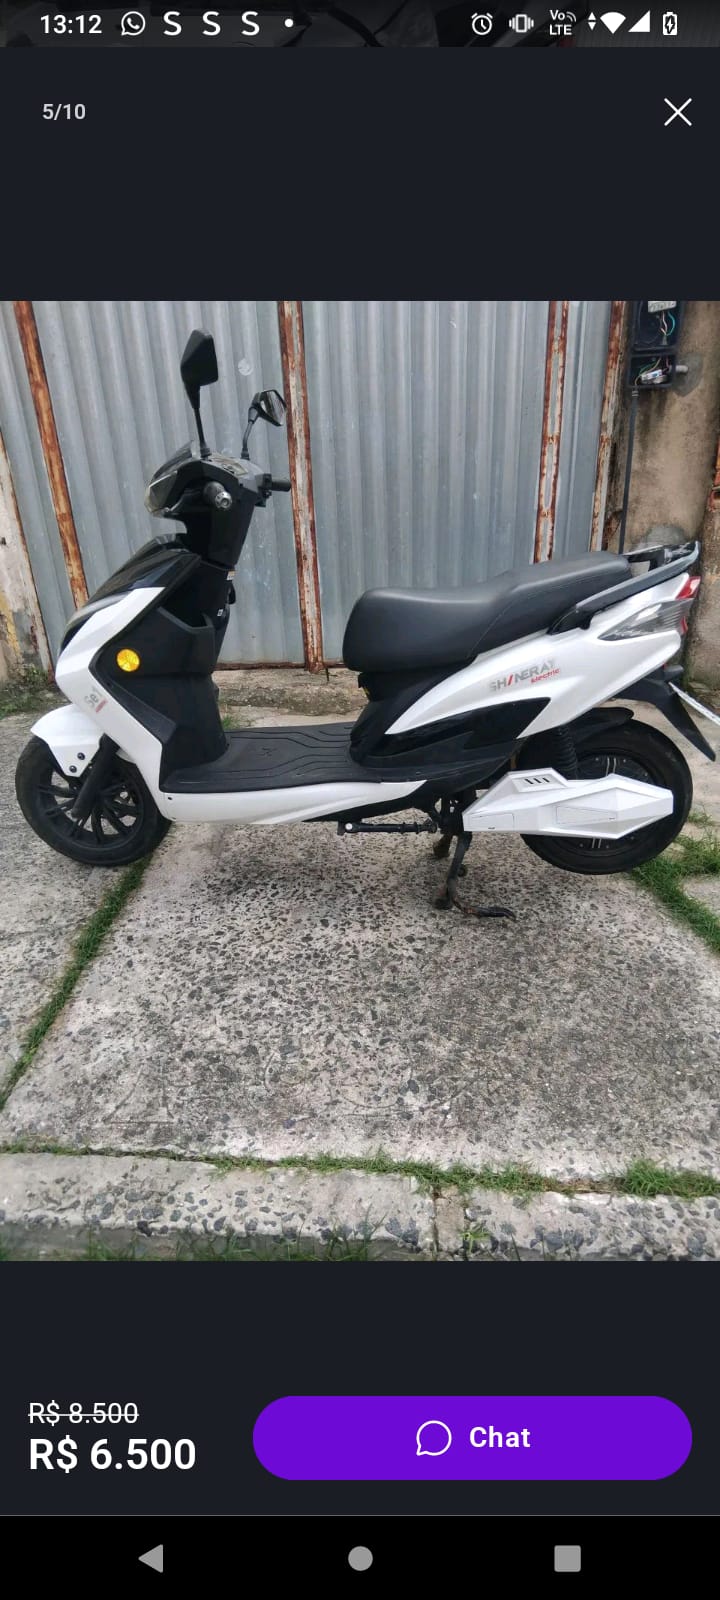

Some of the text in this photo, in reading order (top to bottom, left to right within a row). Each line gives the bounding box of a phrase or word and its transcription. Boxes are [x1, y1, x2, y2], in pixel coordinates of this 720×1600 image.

[40, 14, 102, 34] 13:12
[163, 10, 260, 36] S S S
[549, 24, 572, 36] LTE
[42, 103, 86, 121] 5/10
[28, 1400, 140, 1427] R$ 8.500
[469, 1425, 531, 1448] Chat
[29, 1435, 196, 1474] R$ 6.500
